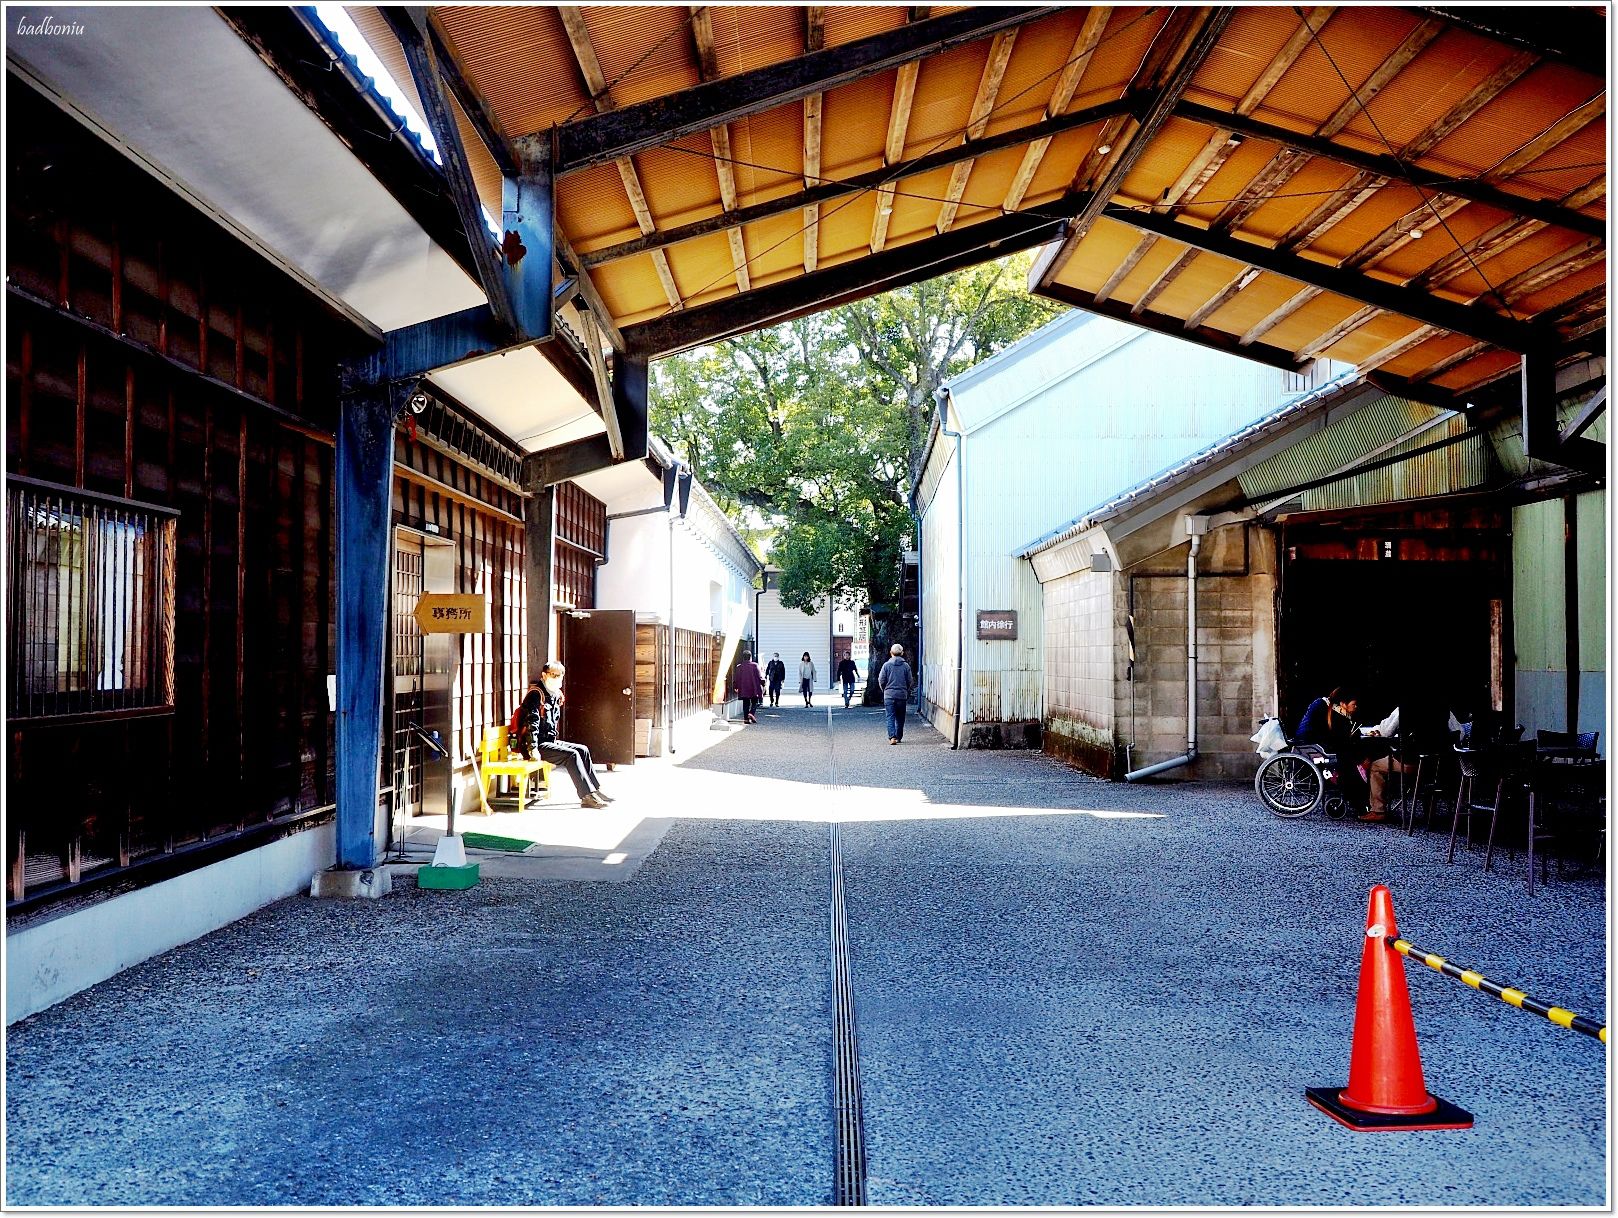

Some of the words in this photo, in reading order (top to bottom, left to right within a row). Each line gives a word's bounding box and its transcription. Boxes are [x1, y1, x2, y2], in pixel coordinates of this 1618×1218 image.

[432, 606, 472, 620] 事務所
[980, 619, 1014, 630] 館内徐行
